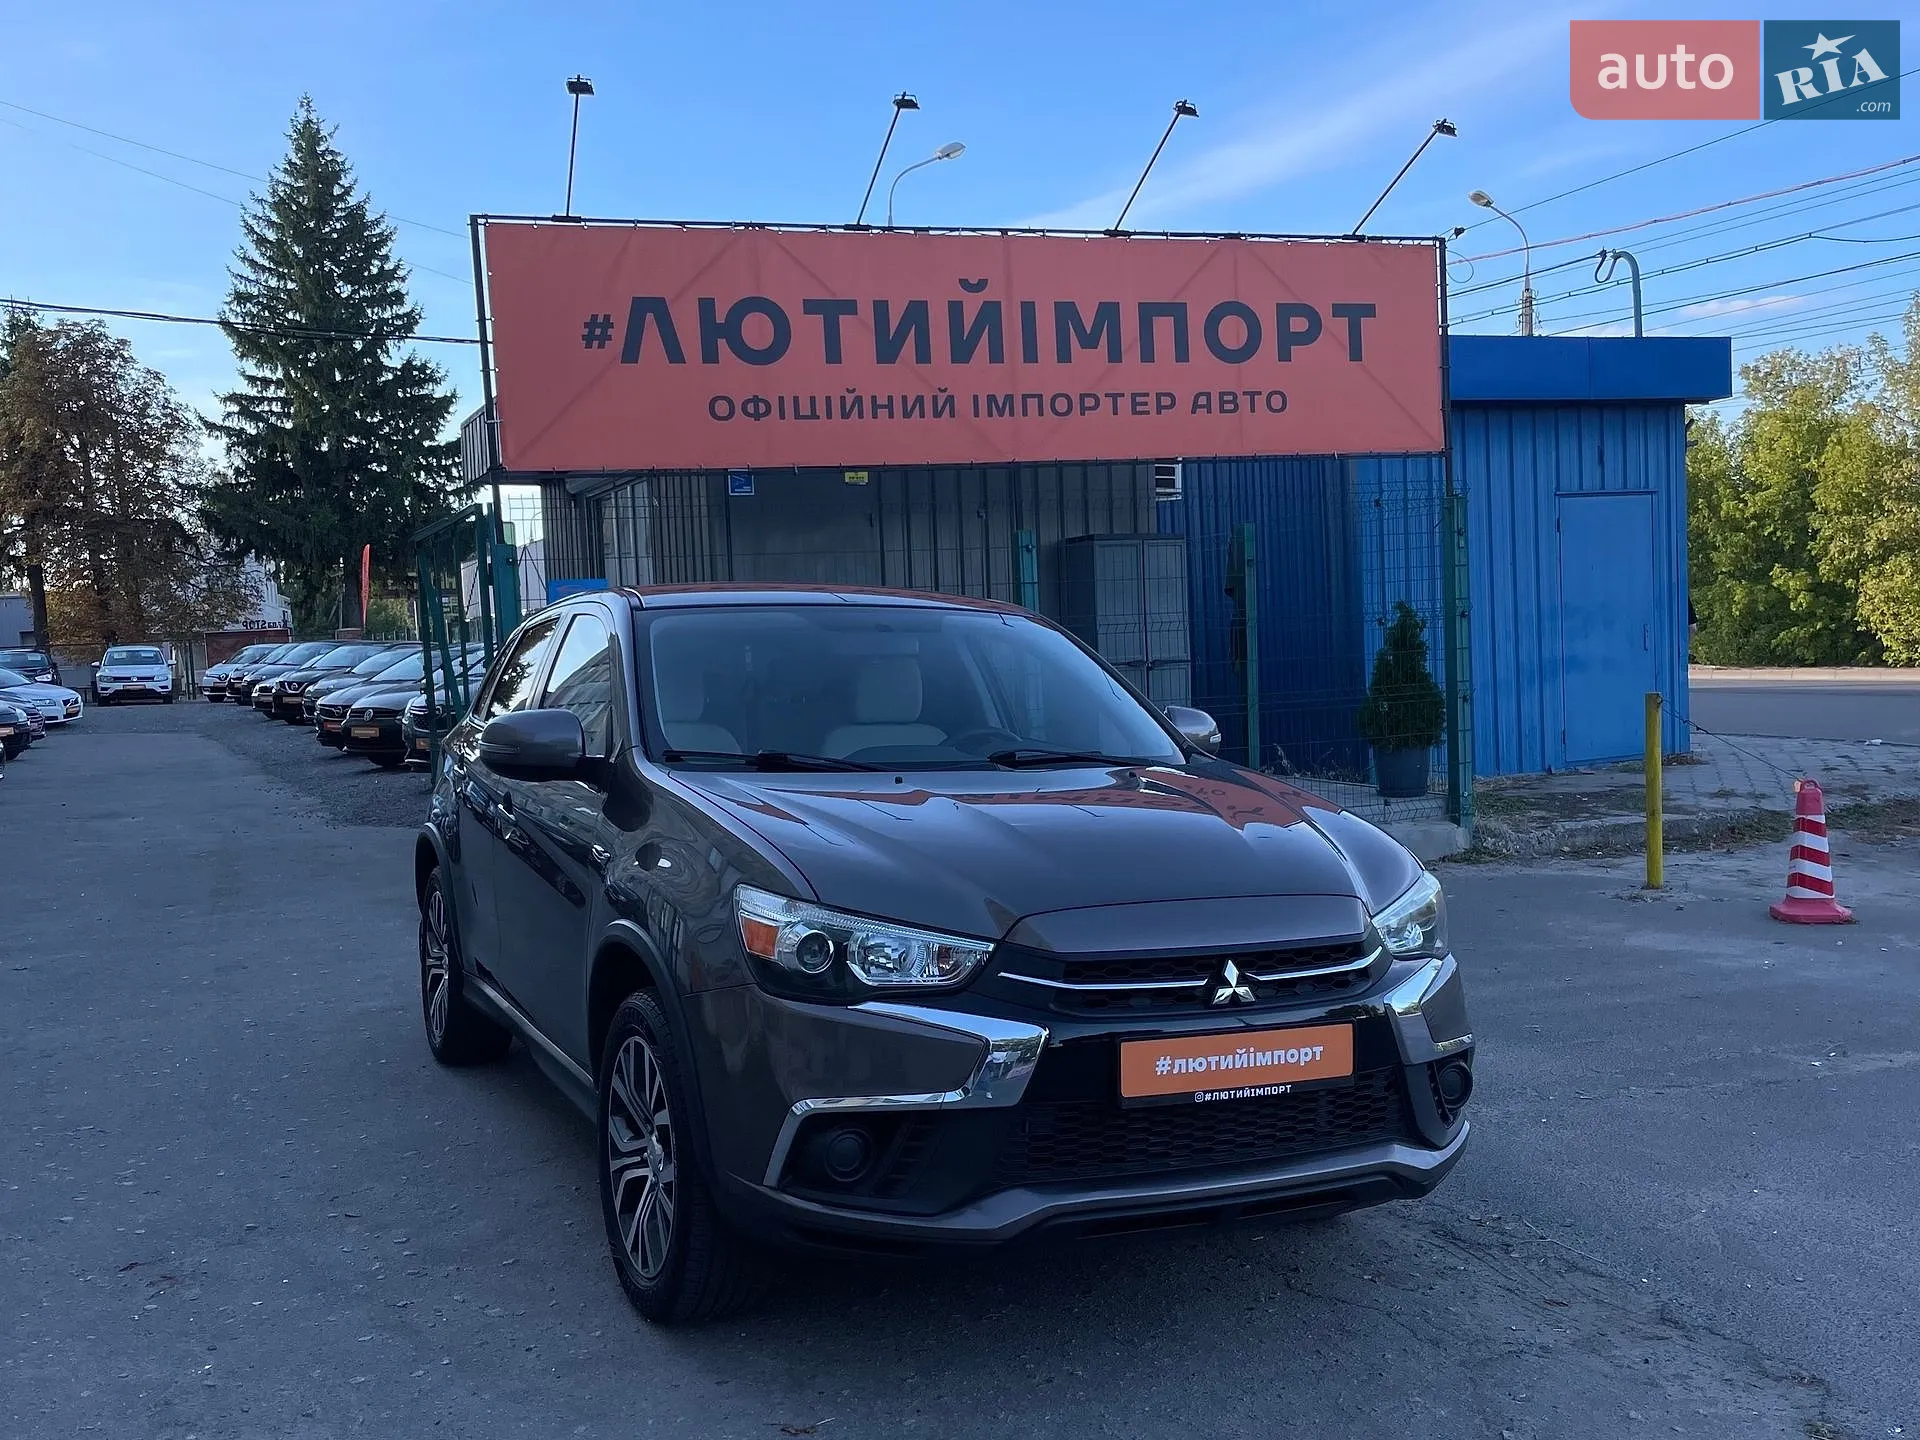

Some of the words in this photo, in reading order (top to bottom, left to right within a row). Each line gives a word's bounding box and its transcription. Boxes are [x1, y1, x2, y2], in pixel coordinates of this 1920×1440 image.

[581, 278, 1377, 366] #ЛЮТИЙІМПОРТ
[708, 387, 956, 422] ОФІЦІЙНИЙ
[973, 391, 1177, 419] ІМПОРТЕР
[1191, 389, 1289, 416] АВТО
[1155, 1045, 1324, 1076] #лютийімпорт
